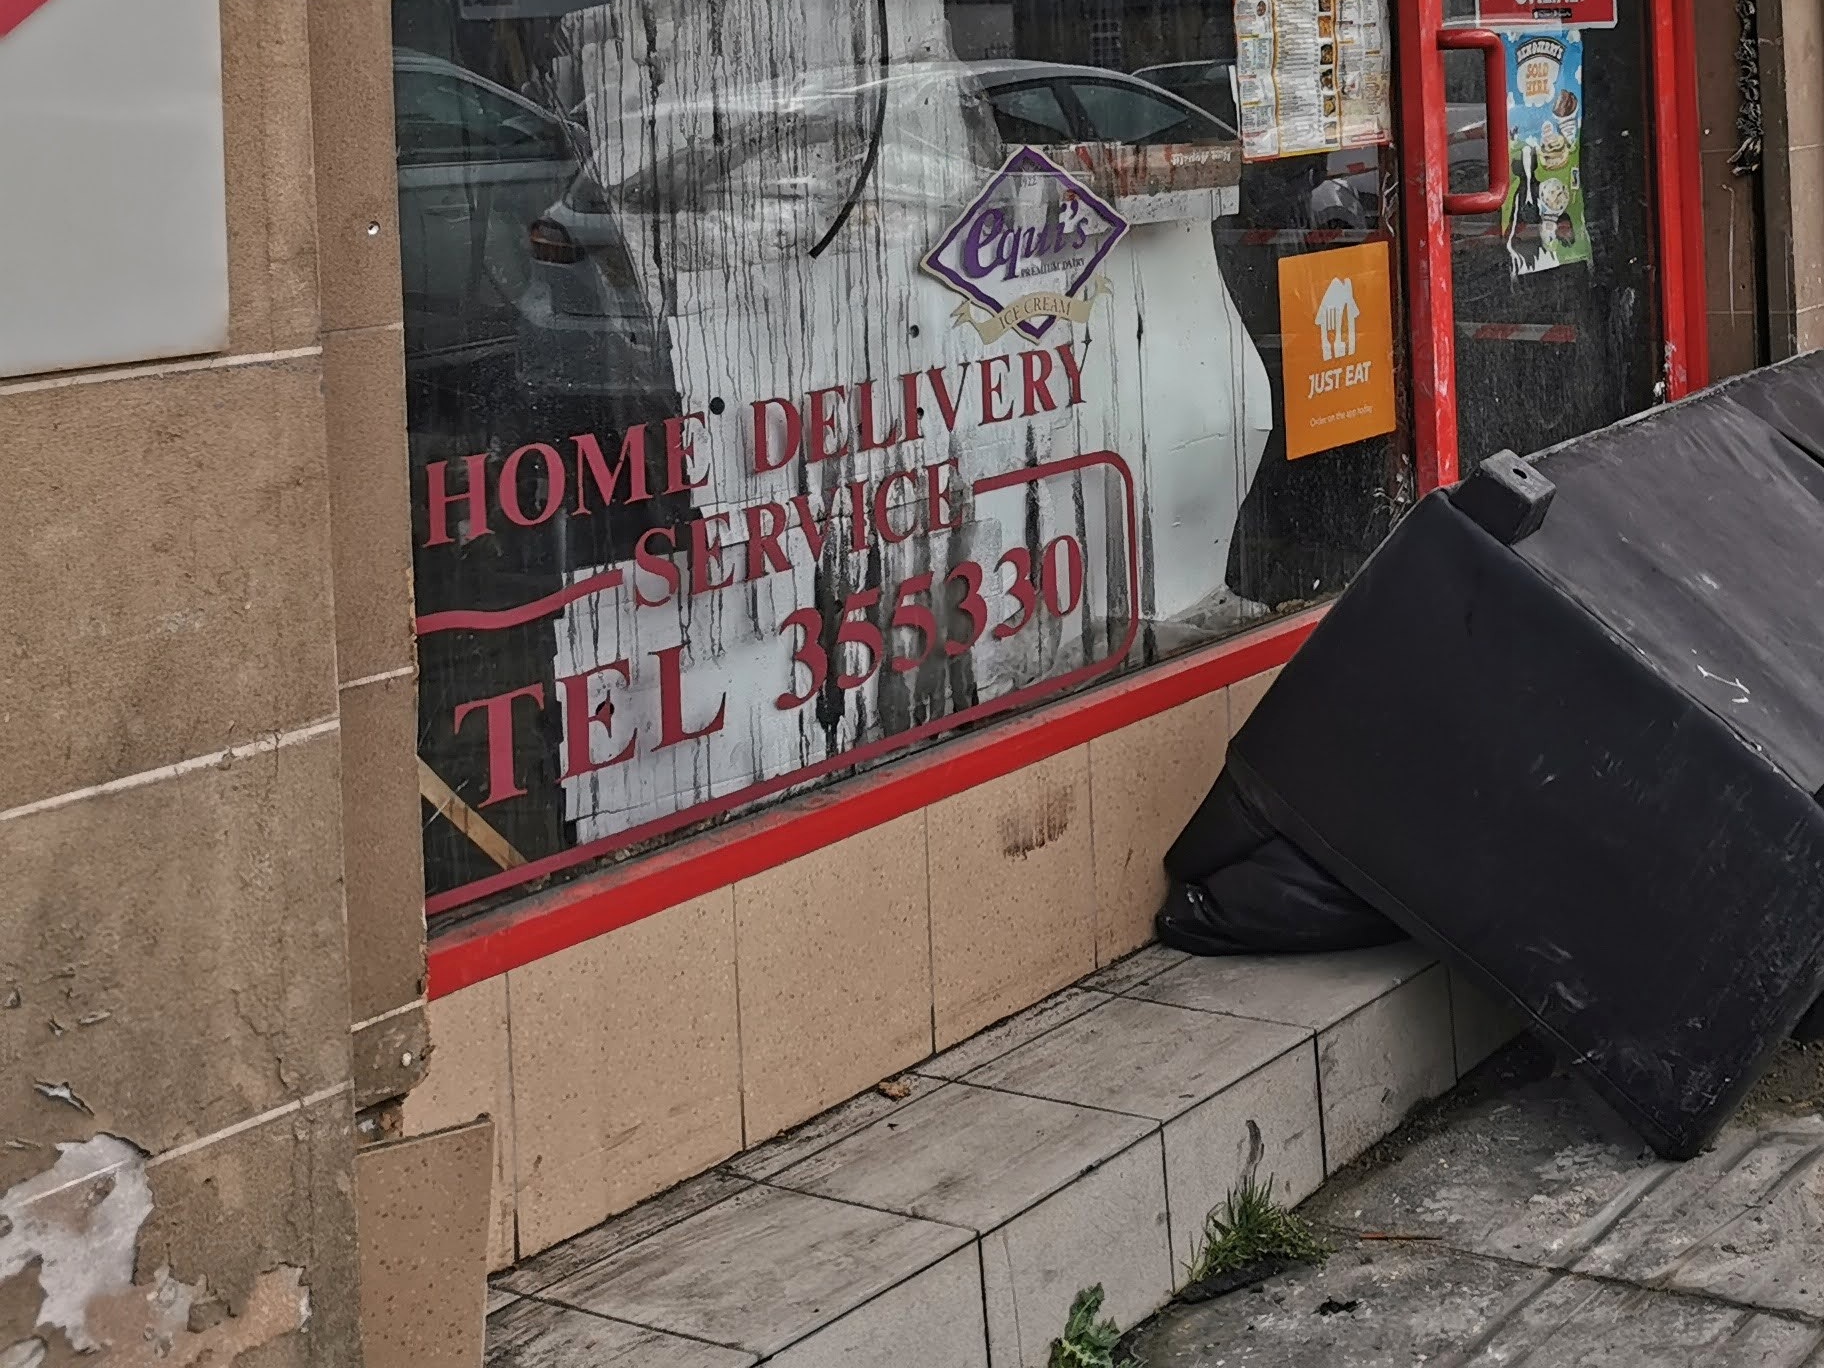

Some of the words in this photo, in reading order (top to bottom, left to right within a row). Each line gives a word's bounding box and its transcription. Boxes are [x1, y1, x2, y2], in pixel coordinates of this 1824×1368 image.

[1525, 81, 1550, 97] HERE
[1526, 62, 1549, 80] SOLD
[1020, 261, 1061, 279] PREMIUM
[1061, 255, 1087, 275] DAIRY
[998, 303, 1021, 330] ICE
[1023, 295, 1073, 318] CREAM
[1307, 367, 1343, 400] JUST
[1345, 360, 1372, 387] EAT
[424, 411, 712, 549] HOME
[749, 341, 1091, 476] DELIVERY
[632, 457, 965, 609] SERVICE
[453, 643, 729, 810] TEL
[774, 535, 1085, 712] 355330
